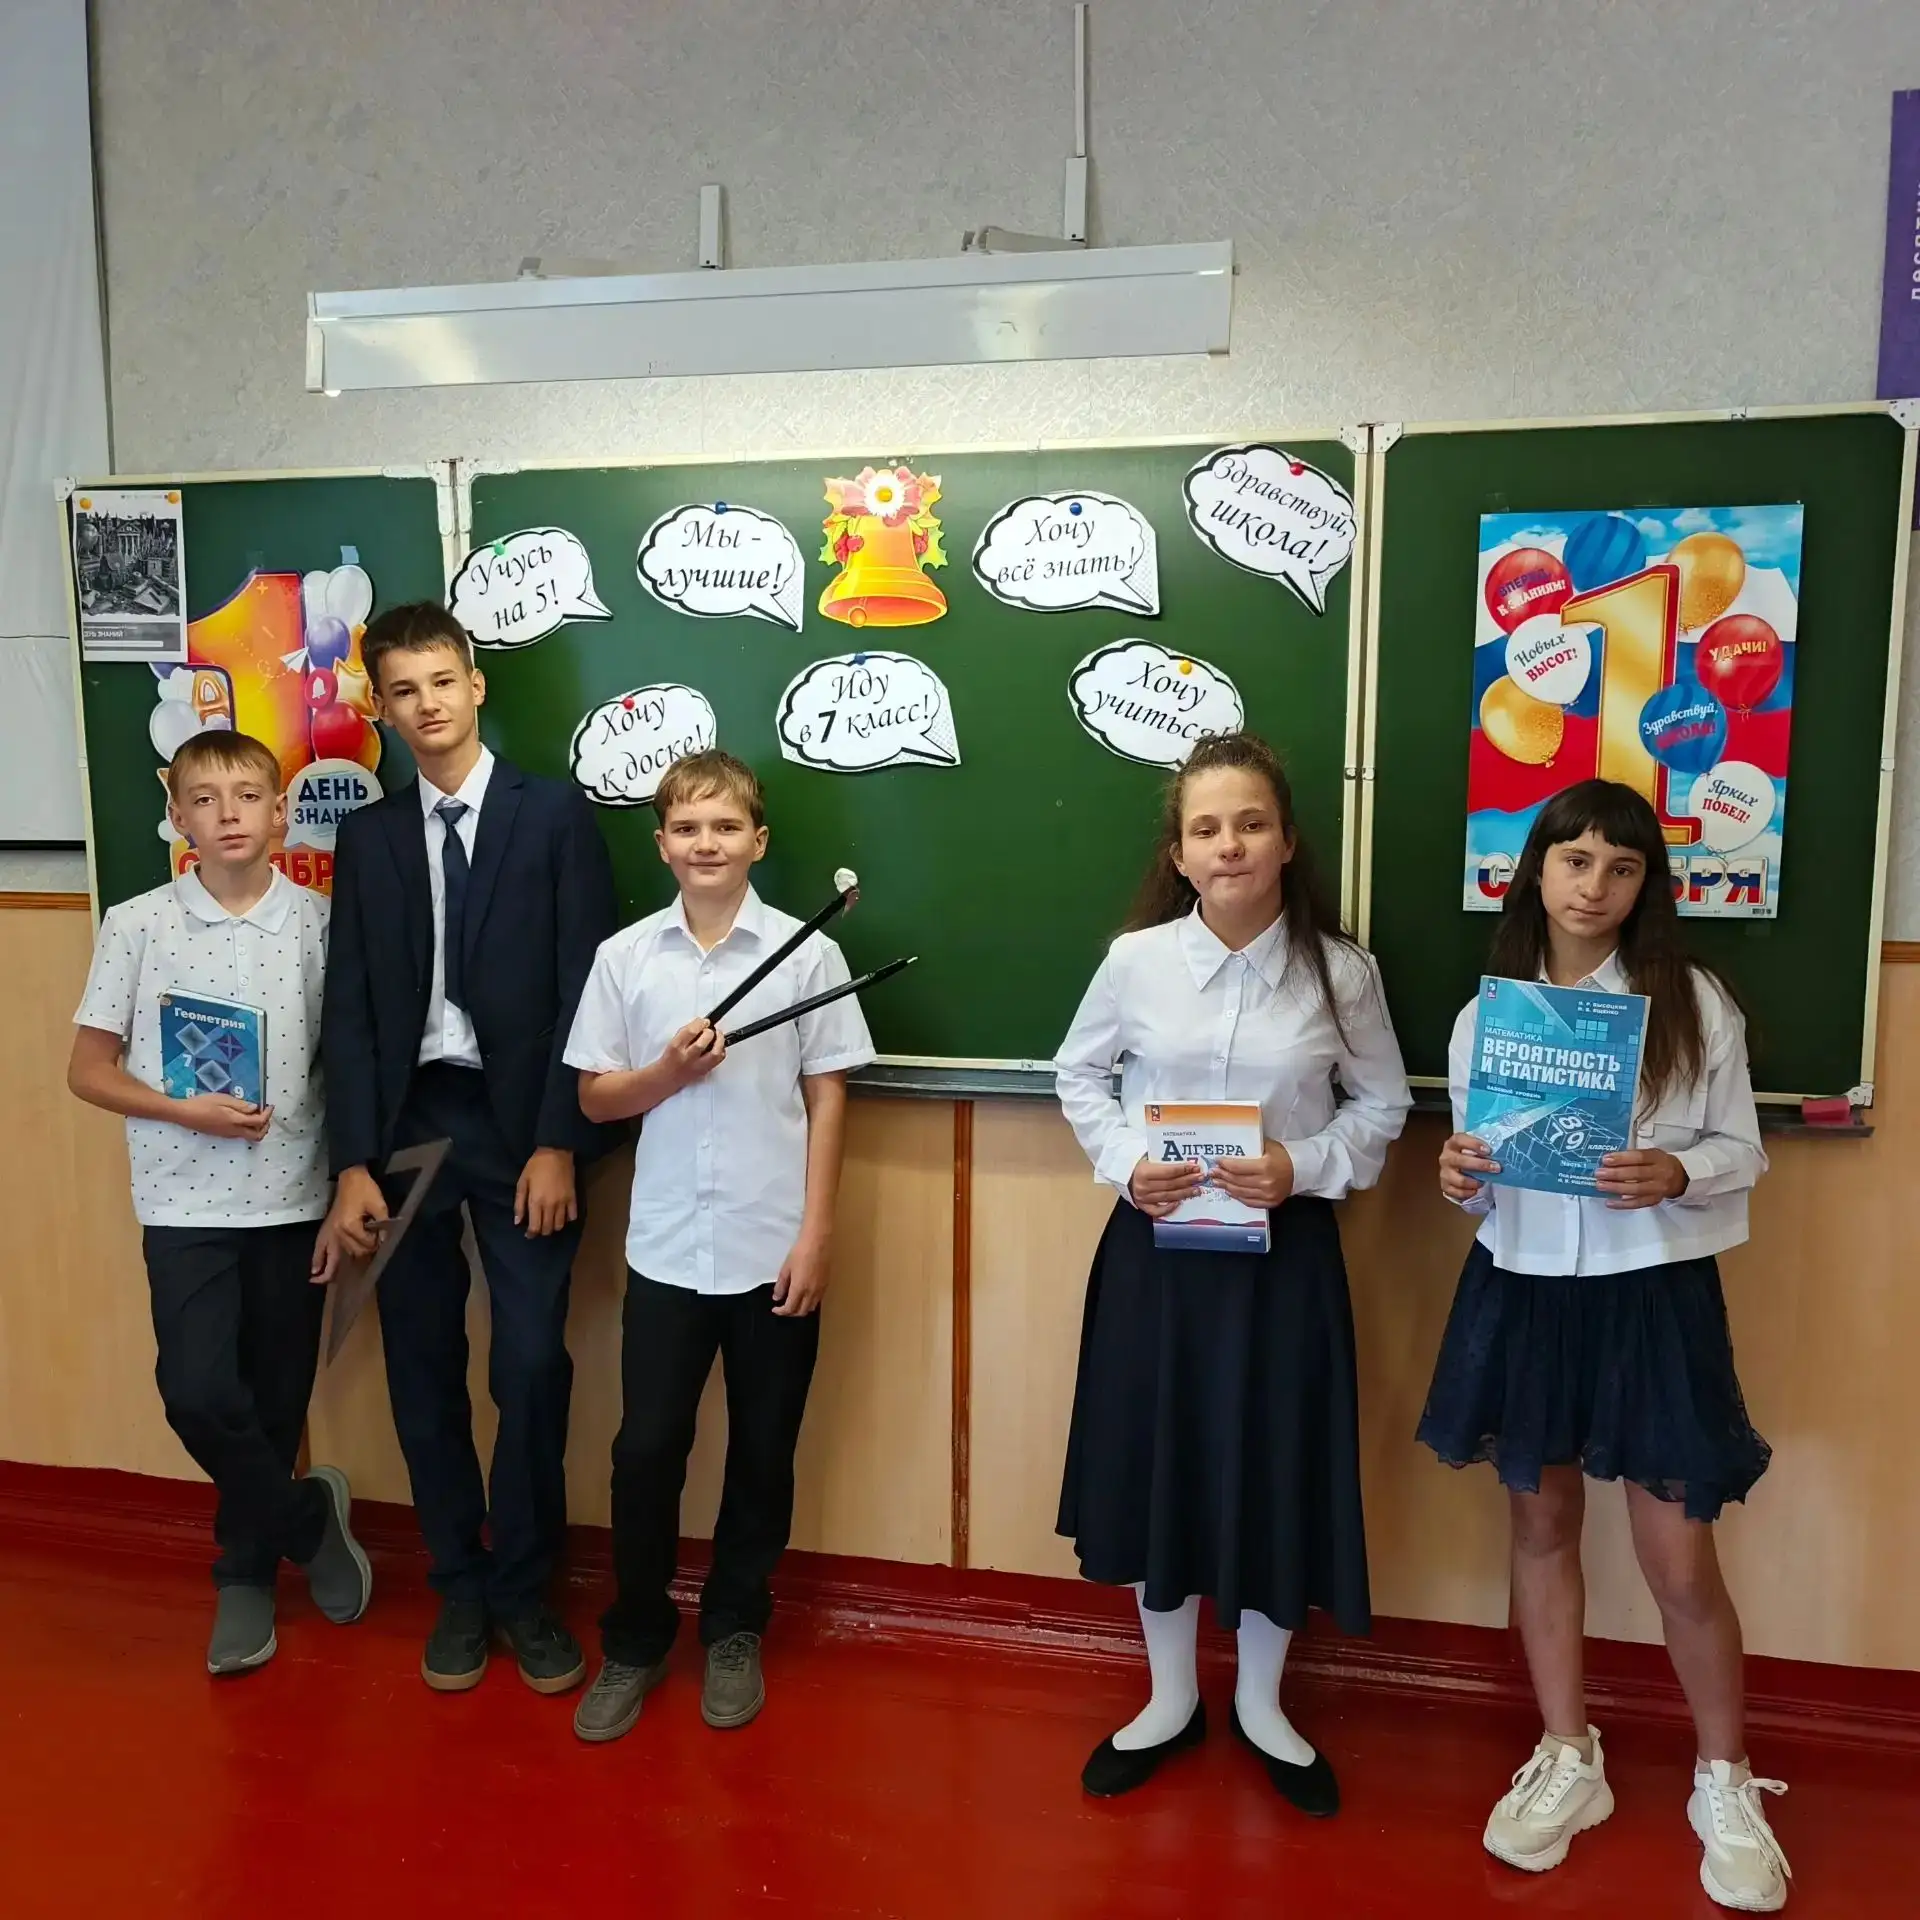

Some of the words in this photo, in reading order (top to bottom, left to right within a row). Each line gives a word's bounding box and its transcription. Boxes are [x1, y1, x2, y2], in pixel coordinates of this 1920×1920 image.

[1213, 457, 1349, 538] Здравствуй,
[682, 520, 742, 548] Мы
[1025, 515, 1095, 548] Хочу
[1210, 500, 1329, 564] школа!
[470, 546, 553, 595] Учусь
[659, 563, 782, 597] лучшие!
[997, 558, 1036, 583] всё
[1043, 546, 1135, 578] знать!
[492, 601, 528, 629] на
[535, 579, 559, 613] 5!
[1514, 633, 1567, 667] Новых
[1525, 648, 1579, 682] ВЫСОТ!
[1708, 641, 1767, 662] УДАЧИ!
[831, 667, 889, 704] Иду
[1126, 661, 1207, 712] Хочу
[600, 697, 665, 745] Хочу
[799, 724, 812, 743] в
[818, 710, 837, 743] 7
[845, 694, 929, 739] класс!
[1643, 702, 1719, 736] Здравствуй,
[600, 768, 628, 793] к
[621, 724, 705, 781] доске!
[298, 778, 368, 802] ДЕНЬ
[1708, 779, 1760, 807] Ярких
[294, 807, 353, 825] ЗНАН
[1702, 797, 1751, 824] ПОБЕД!
[173, 1007, 246, 1030] Геометрия
[1484, 1026, 1543, 1042] МАТЕМАТИКА
[183, 1053, 192, 1067] 7
[1482, 1036, 1621, 1072] ВЕРОЯТНОСТЬ
[1480, 1055, 1494, 1073] И
[1499, 1059, 1616, 1091] СТАТИСТИКА
[233, 1085, 245, 1099] 9
